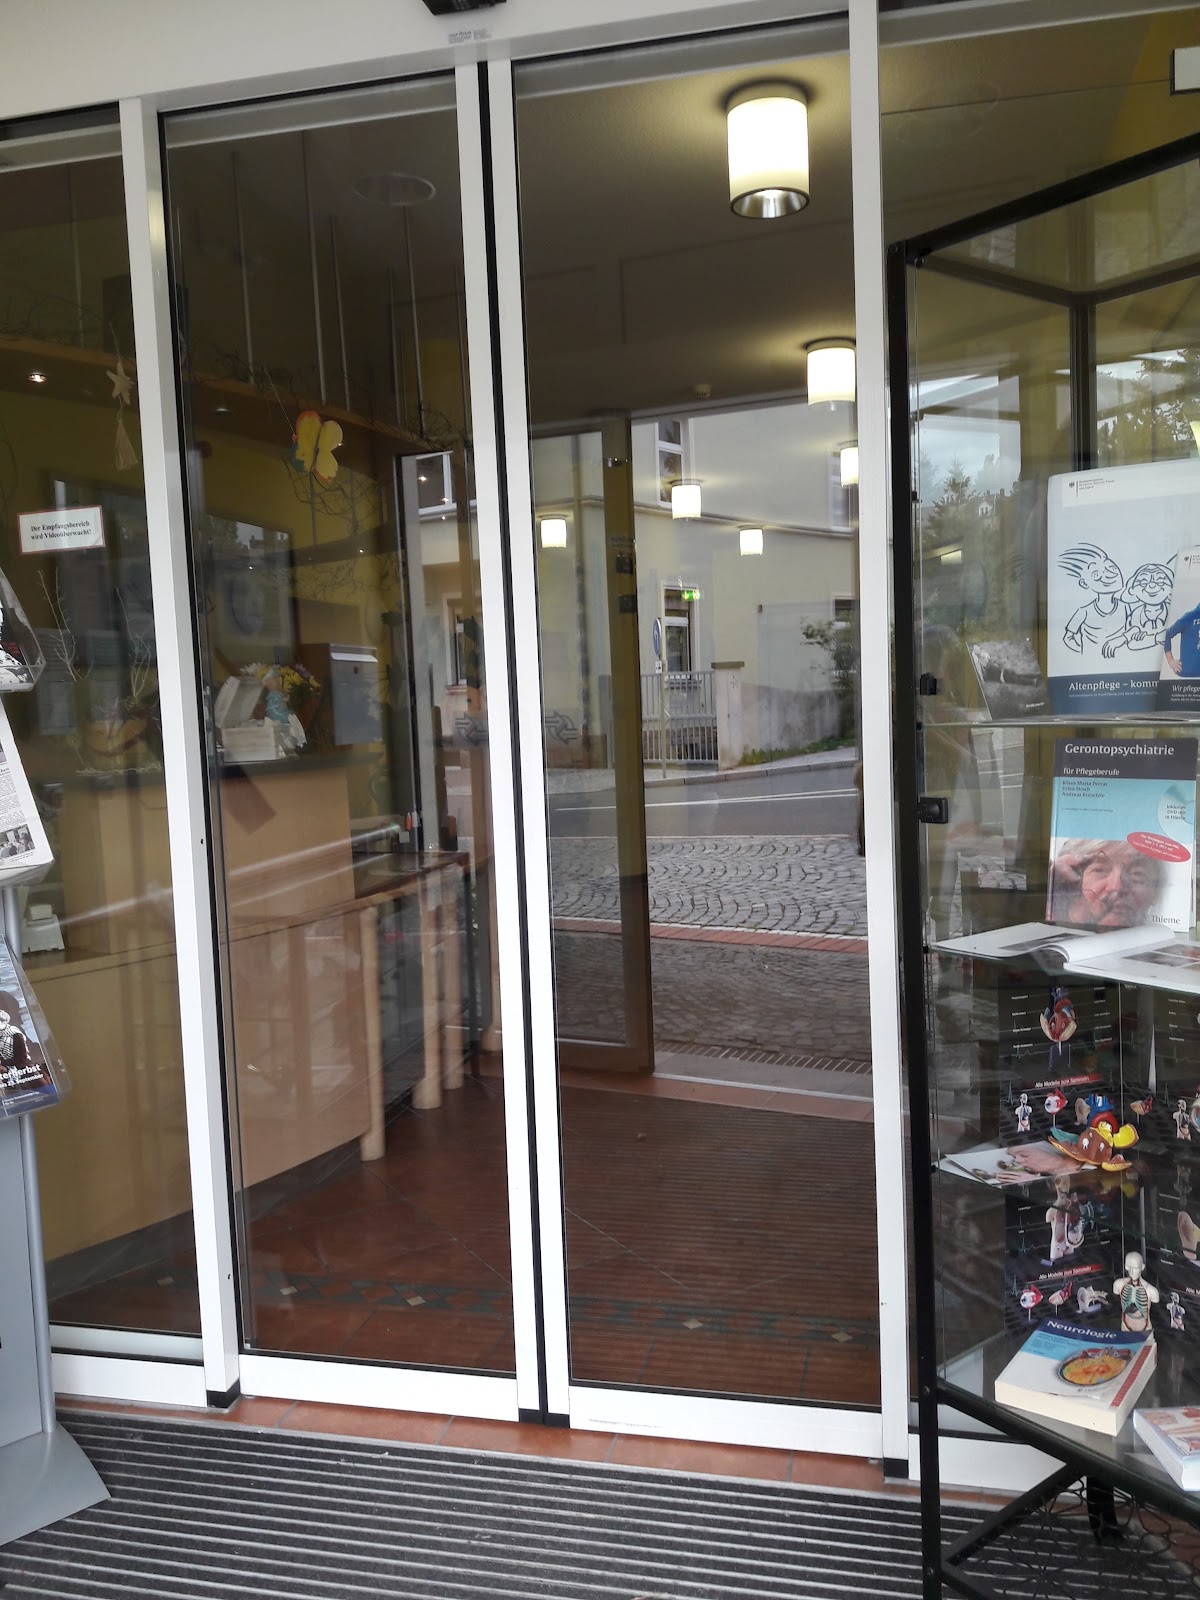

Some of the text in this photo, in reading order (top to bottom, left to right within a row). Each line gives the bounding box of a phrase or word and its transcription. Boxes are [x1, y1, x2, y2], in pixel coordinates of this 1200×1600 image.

[42, 520, 90, 531] Empfangsbereich
[31, 532, 43, 540] wird
[1069, 680, 1121, 691] Altenpflege
[1064, 743, 1175, 757] Gerontopsychiatrie
[1063, 767, 1120, 776] für Pflegeberufe
[1151, 914, 1181, 924] Thieme
[1047, 1320, 1117, 1339] Neurologie
